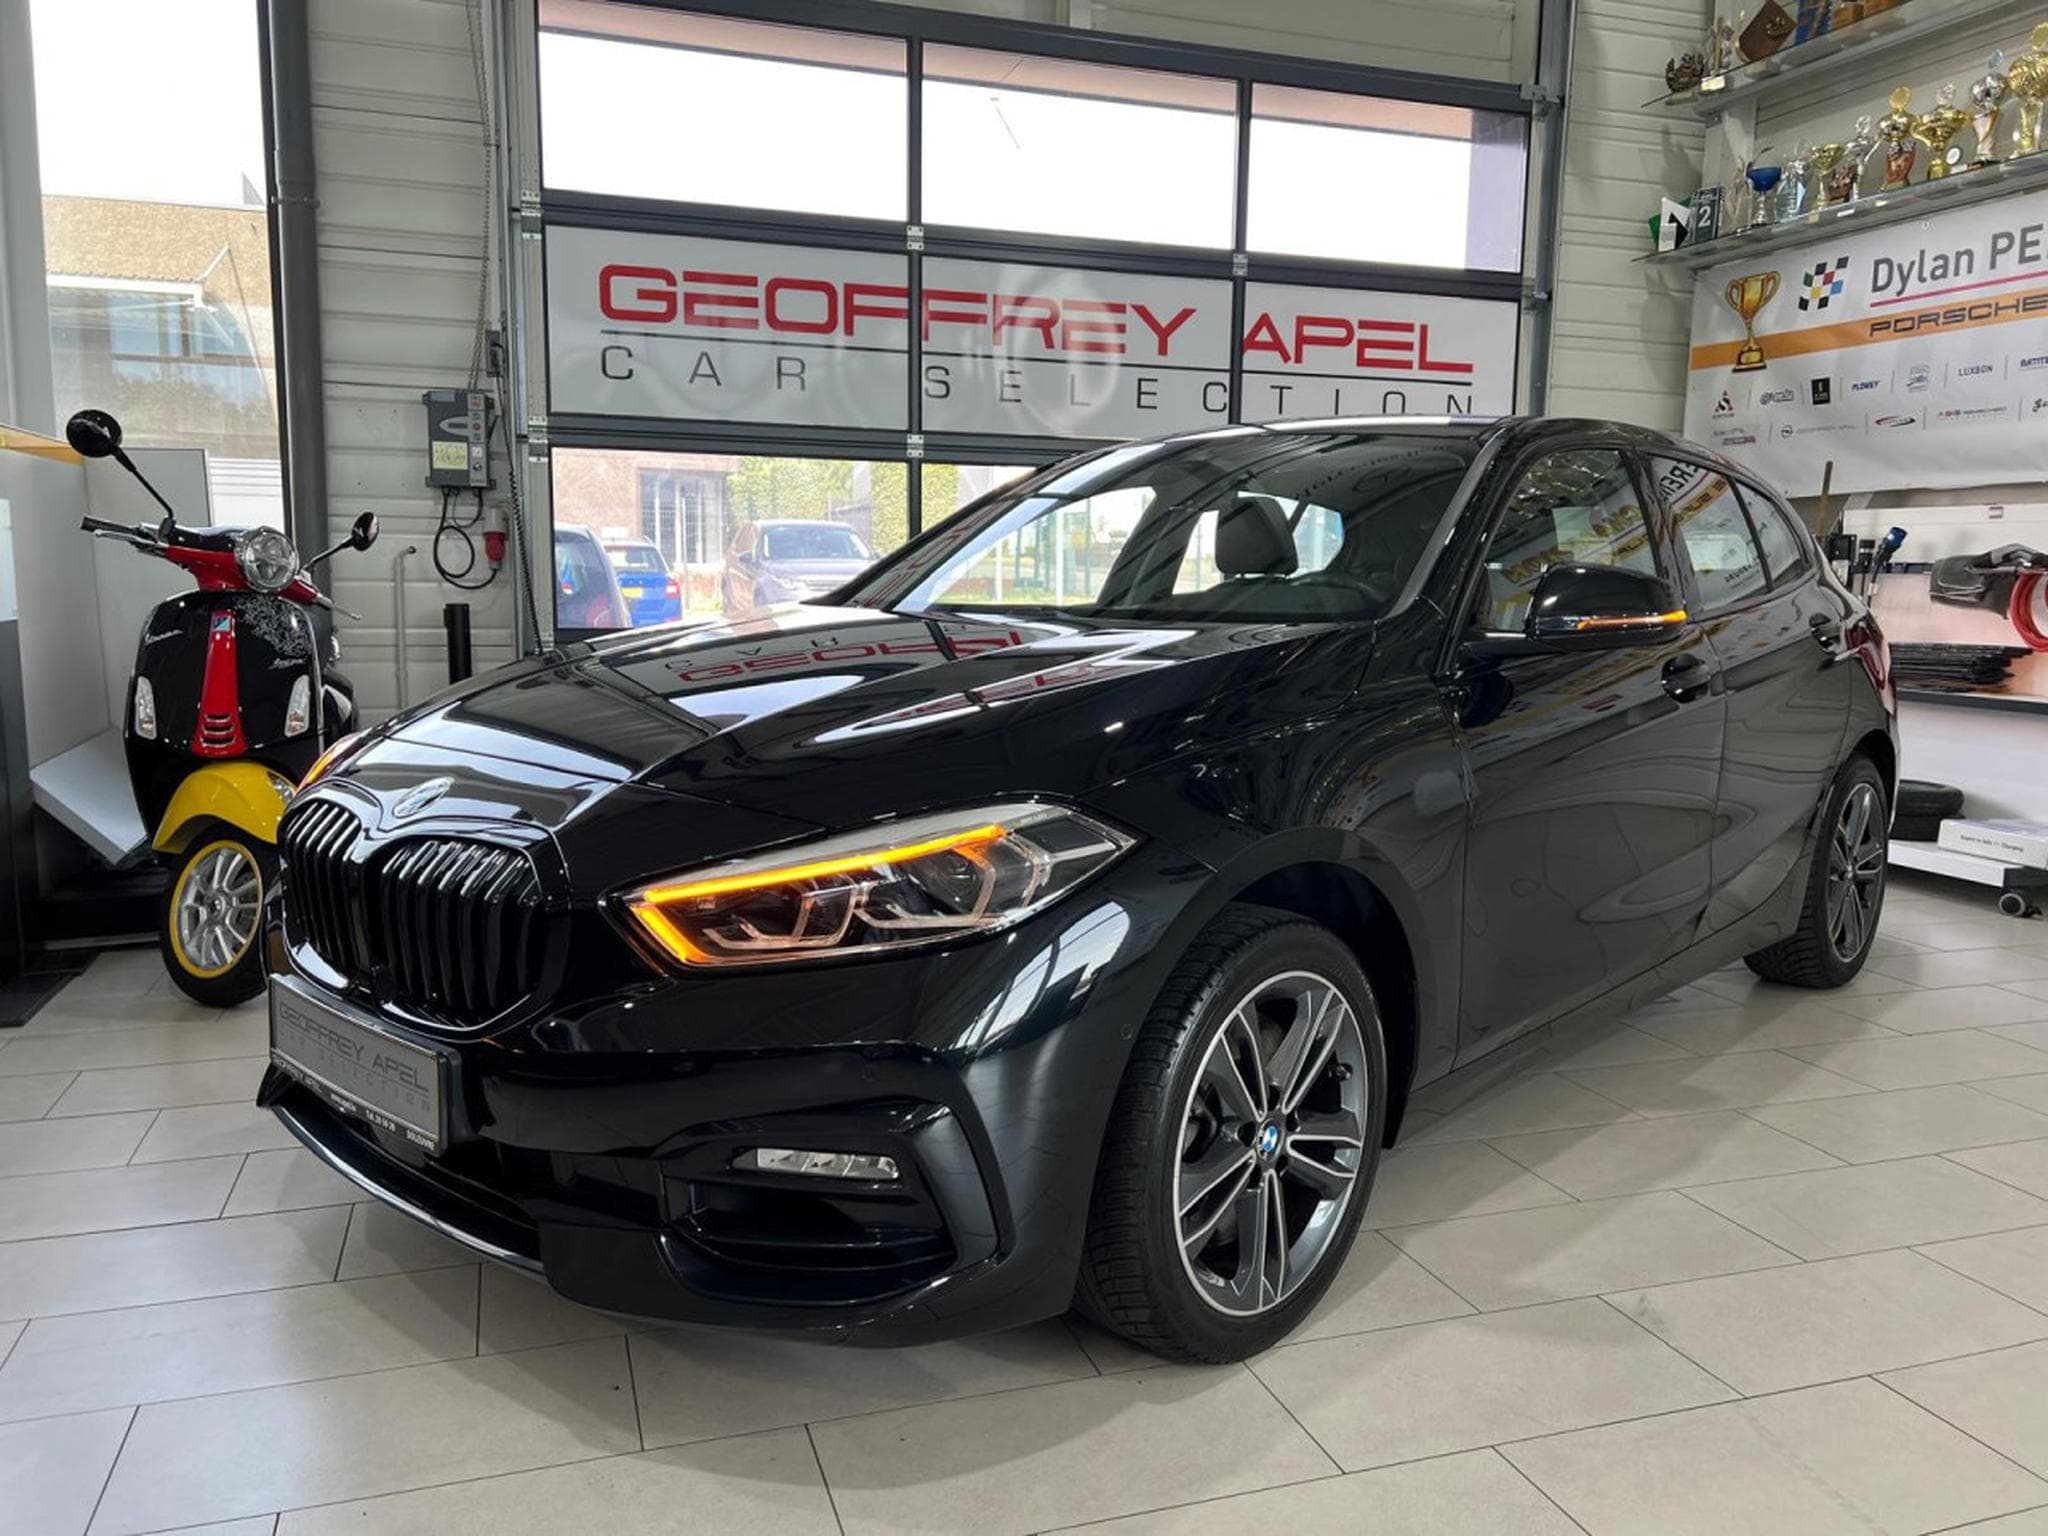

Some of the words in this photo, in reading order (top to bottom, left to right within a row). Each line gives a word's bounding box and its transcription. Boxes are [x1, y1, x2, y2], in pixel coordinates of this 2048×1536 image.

[1871, 249, 1975, 297] Dylan
[1989, 223, 2048, 270] PE
[599, 264, 1197, 356] GEOFFREY
[1243, 312, 1474, 373] APEL
[1869, 293, 2048, 337] PORSCHE
[600, 345, 807, 392] CAR
[924, 365, 1473, 416] SELECTION
[372, 1053, 429, 1093] APEL
